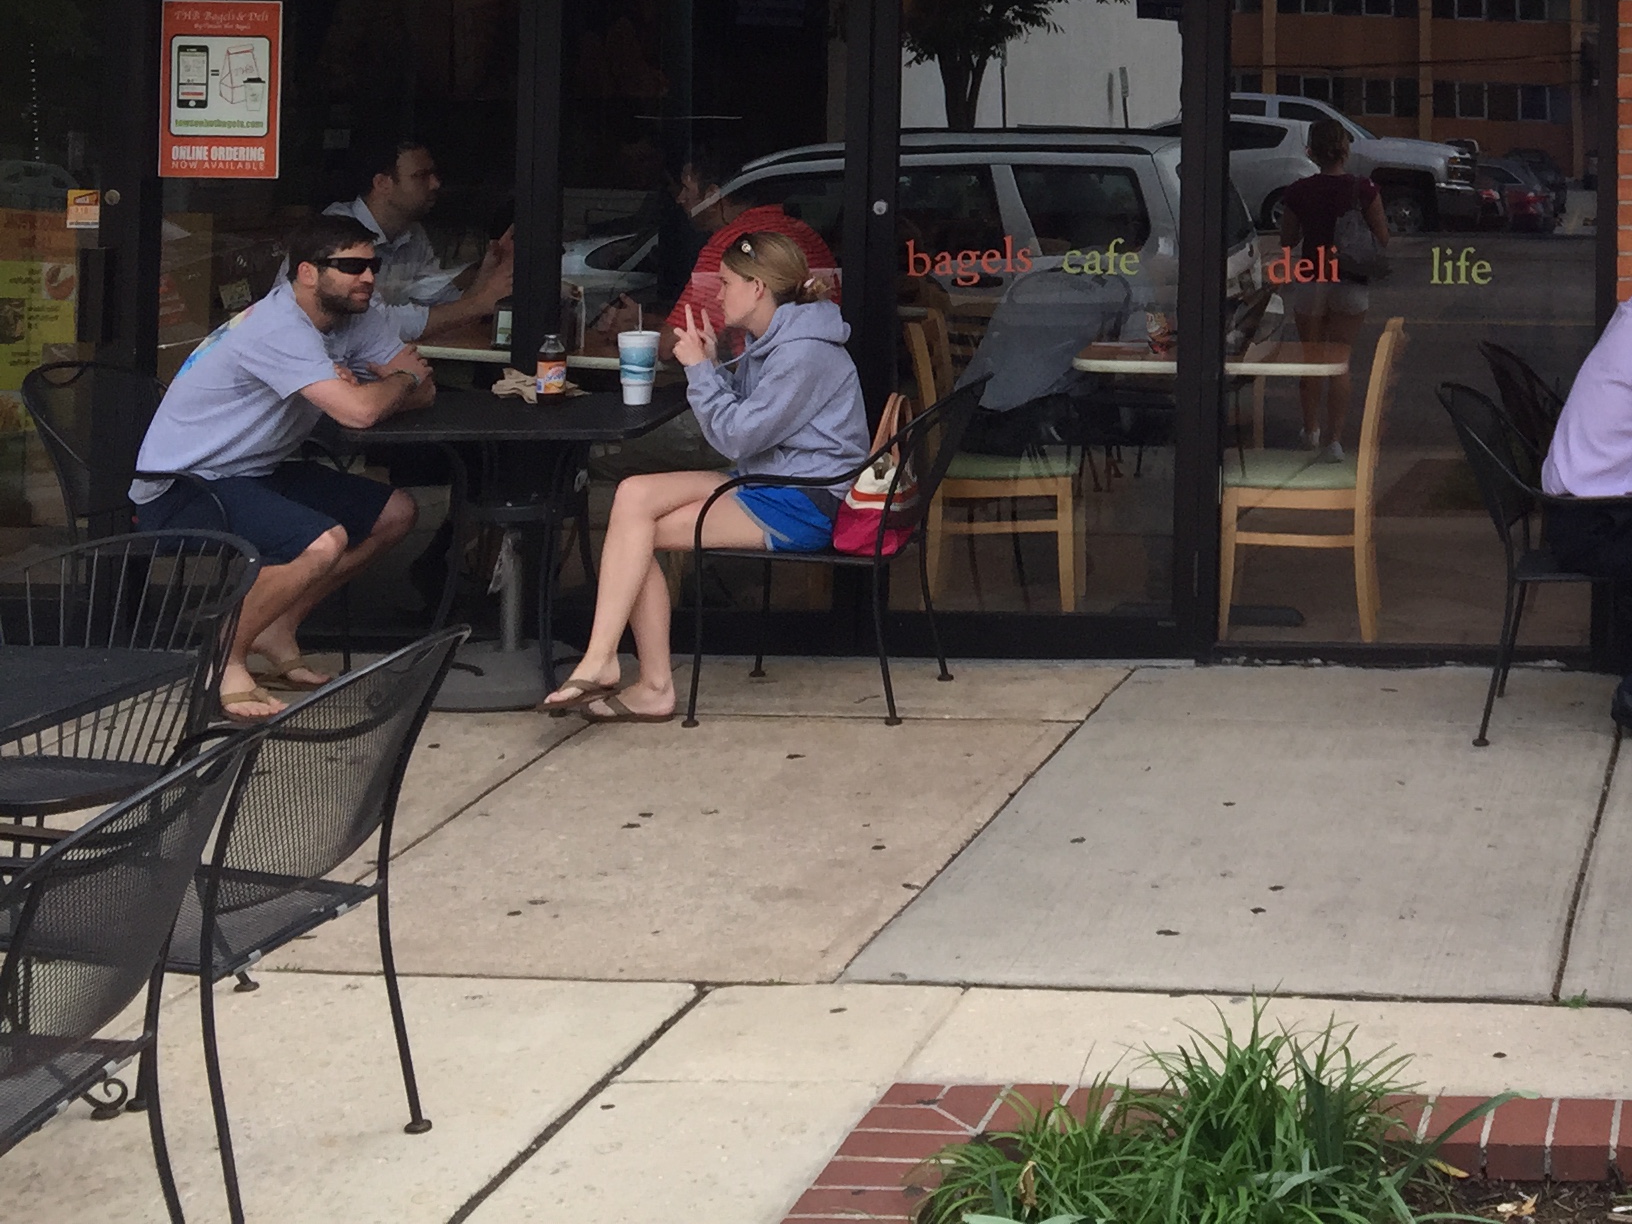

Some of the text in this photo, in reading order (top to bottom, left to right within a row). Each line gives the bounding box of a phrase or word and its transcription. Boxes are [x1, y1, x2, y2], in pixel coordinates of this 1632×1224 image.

[171, 145, 266, 162] ONLINE ORDERING
[171, 161, 265, 171] NOW AVAILABLE
[906, 236, 1493, 286] bagels cafe deli life
